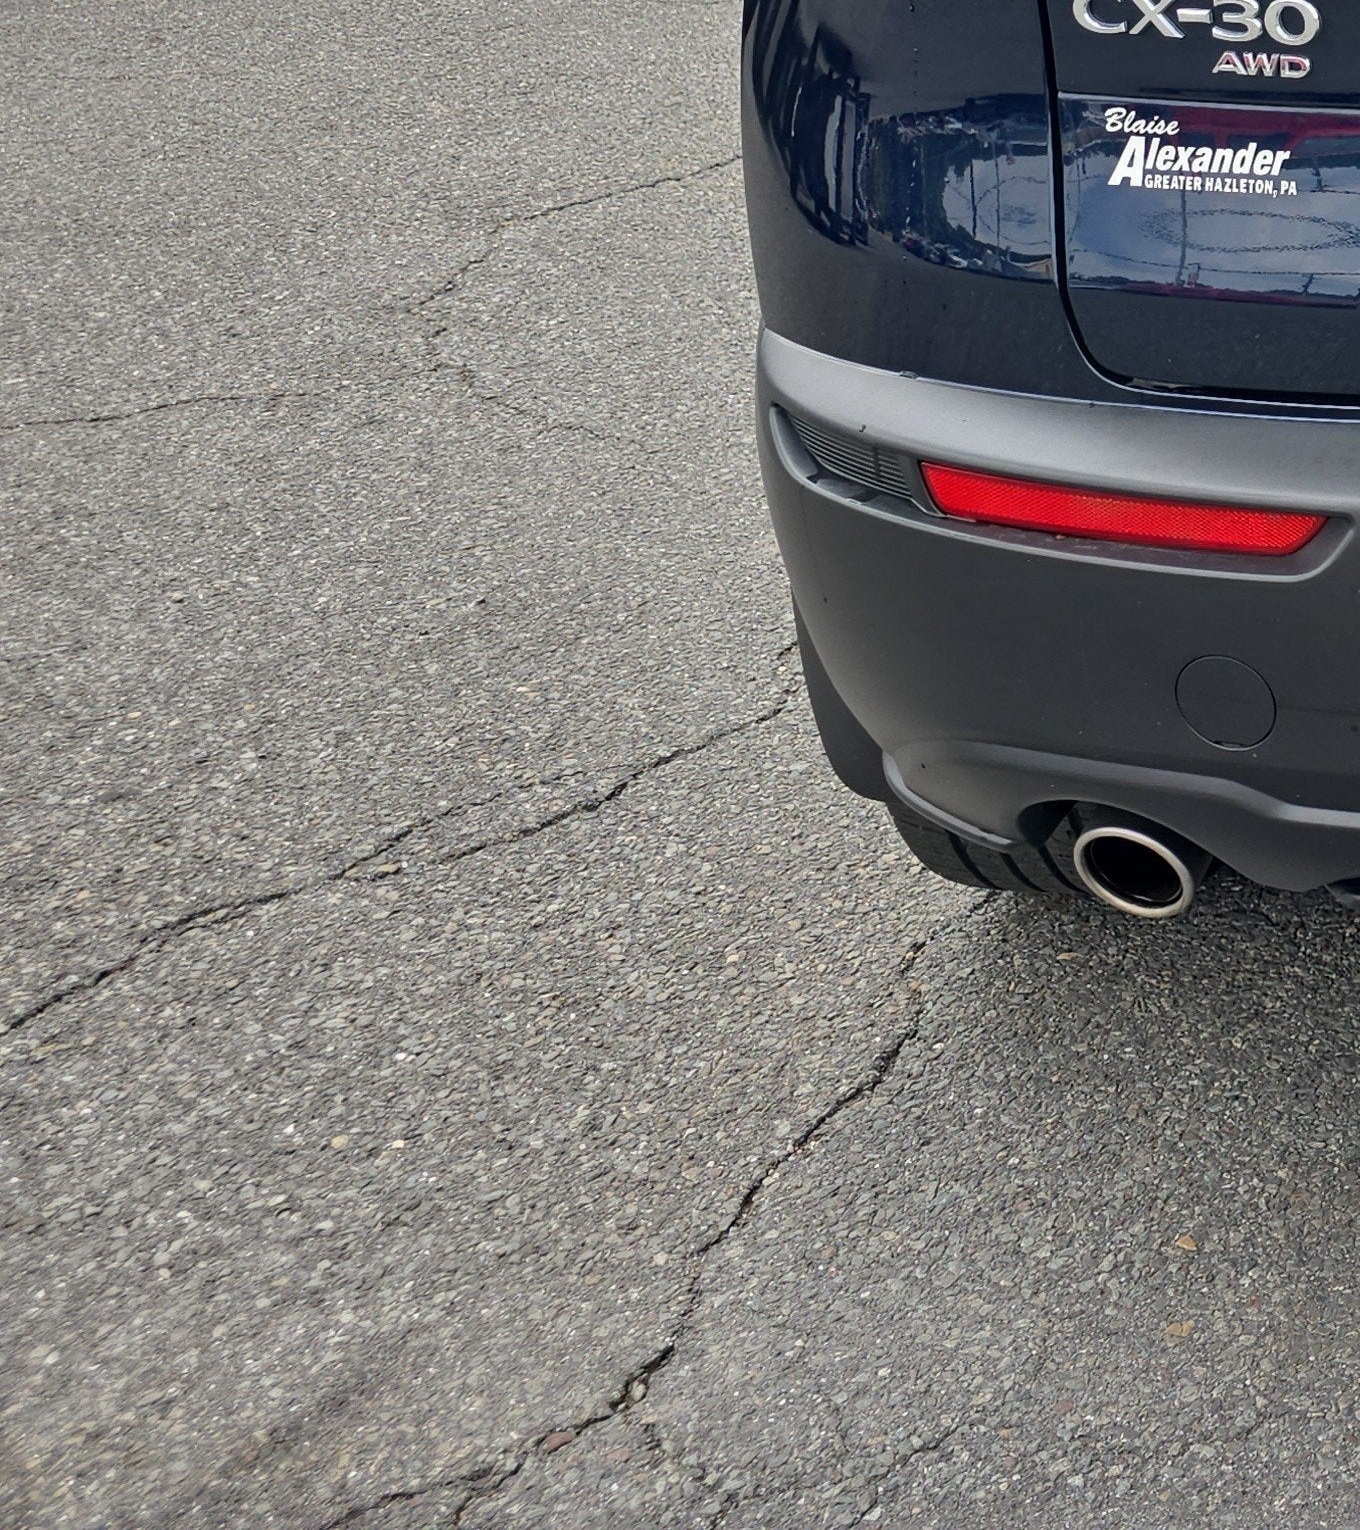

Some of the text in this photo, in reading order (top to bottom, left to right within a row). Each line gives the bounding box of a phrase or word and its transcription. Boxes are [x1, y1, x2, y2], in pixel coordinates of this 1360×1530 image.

[1212, 50, 1311, 79] AWD
[1104, 107, 1179, 135] Blaise
[1107, 136, 1290, 187] Alexander
[1144, 173, 1202, 192] GREATER
[1280, 178, 1298, 196] PA
